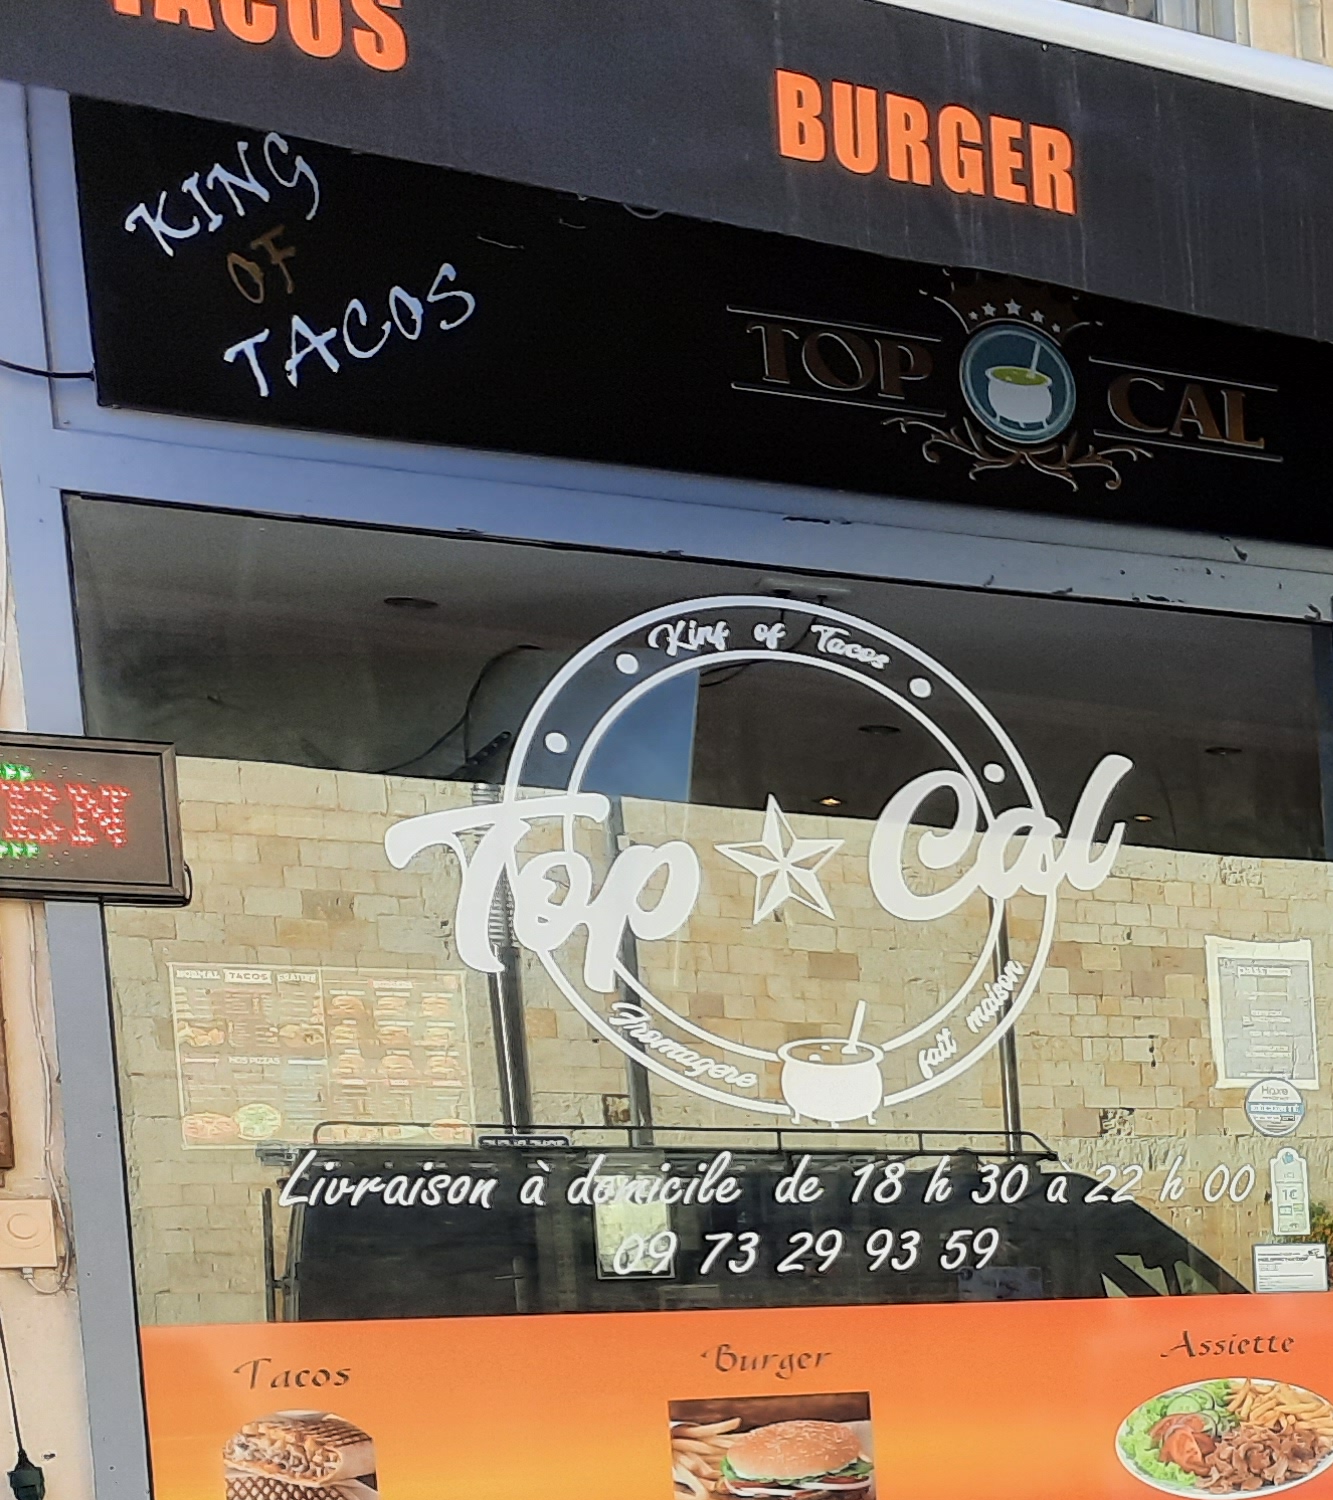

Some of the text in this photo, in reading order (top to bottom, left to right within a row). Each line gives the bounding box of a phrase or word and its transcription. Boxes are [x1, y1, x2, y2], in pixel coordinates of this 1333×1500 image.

[775, 67, 1078, 216] BURGER
[125, 132, 321, 257] KING
[226, 227, 296, 304] OF
[223, 263, 477, 397] TACOS
[746, 322, 1267, 450] TOP CAL
[753, 621, 786, 650] of
[810, 623, 891, 670] Tacos
[868, 754, 1133, 922] Cal
[385, 794, 700, 992] Top
[228, 971, 269, 981] TACOS
[918, 959, 1026, 1080] fait maison
[280, 1150, 1256, 1208] Livraison à domicile de 18 h 30 à 22 h 00
[612, 1227, 1000, 1277] 09 73 29 93 59
[233, 1357, 352, 1390] Tacos
[701, 1341, 832, 1380] Burger
[1160, 1329, 1295, 1359] Assiette
